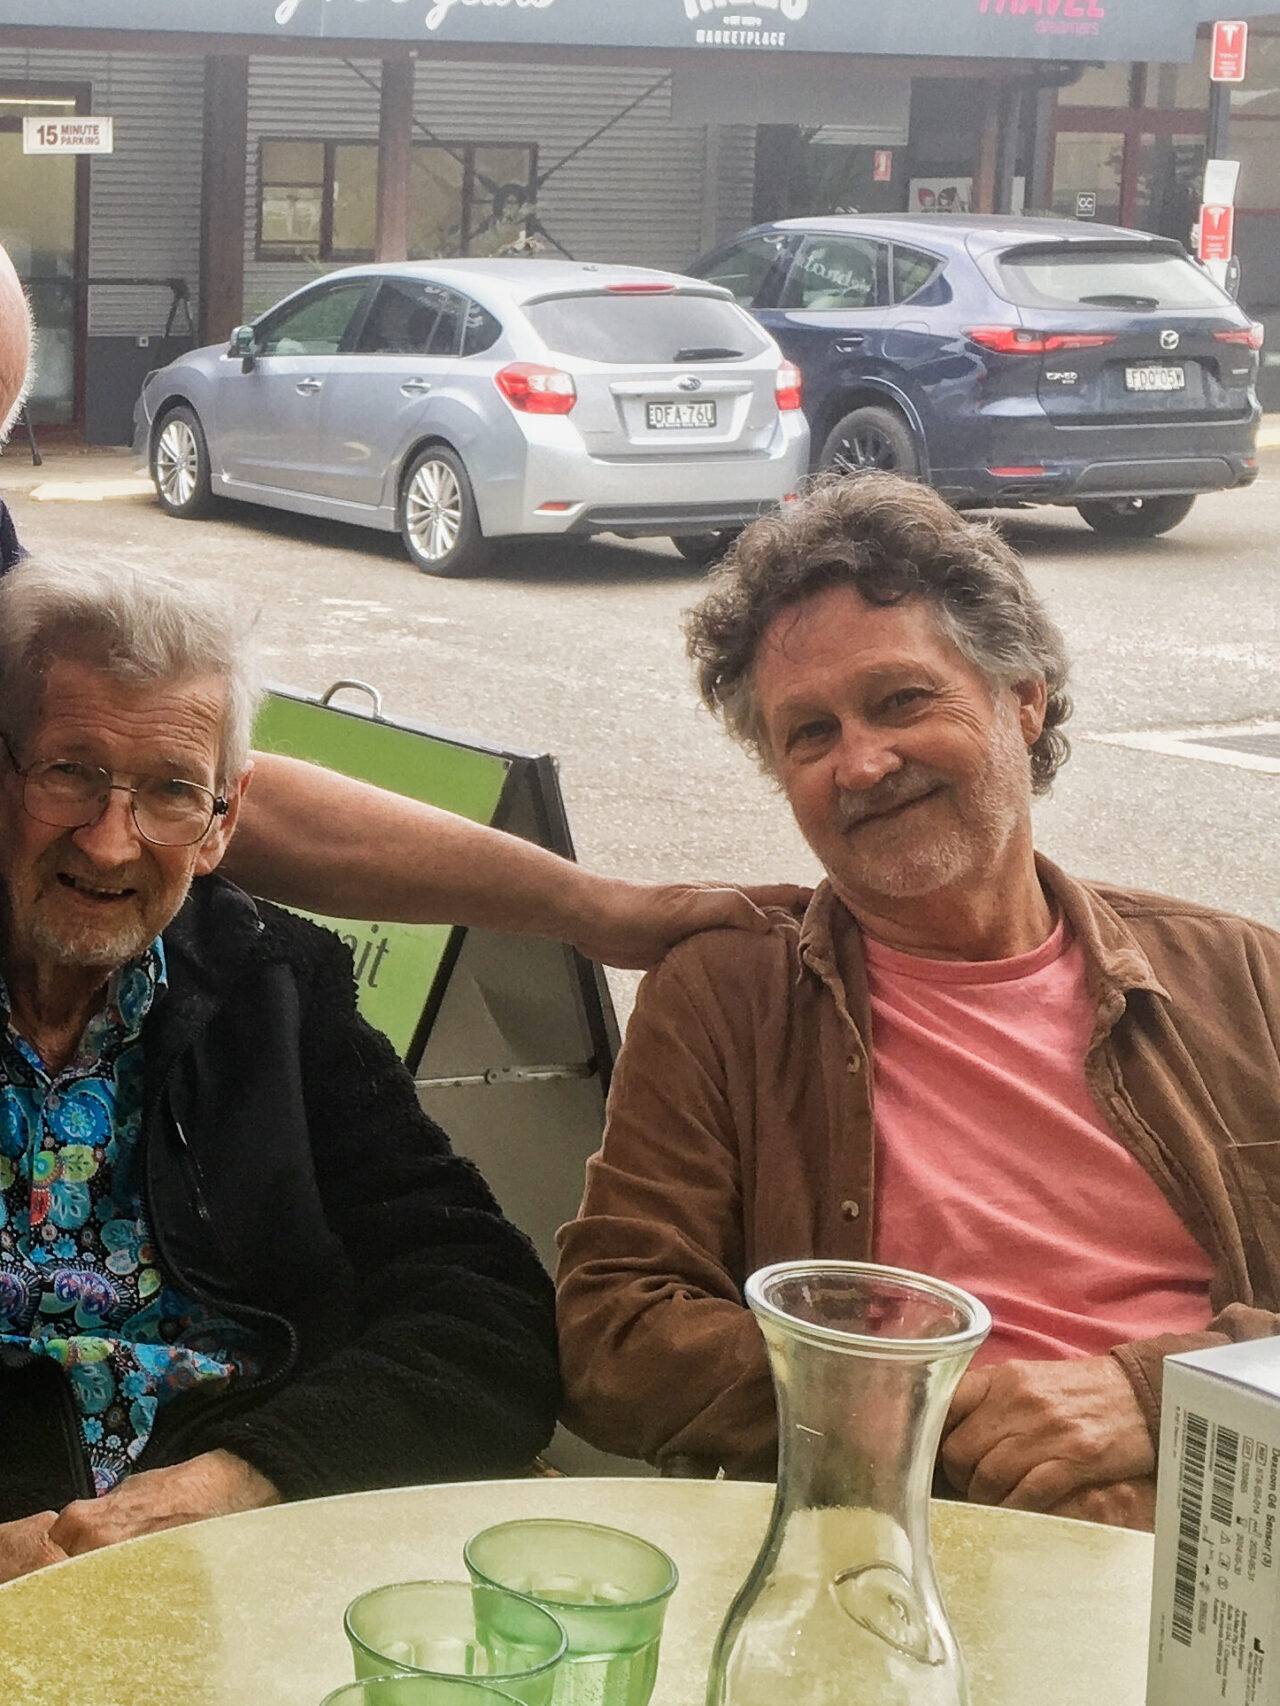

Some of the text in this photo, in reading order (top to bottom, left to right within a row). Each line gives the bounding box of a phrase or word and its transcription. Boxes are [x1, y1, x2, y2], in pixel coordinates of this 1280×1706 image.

[696, 29, 785, 46] MARKETPLACE
[37, 125, 99, 145] 15 MINUTE
[61, 136, 99, 145] PARKING
[1269, 1448, 1280, 1491] Dexcom
[1267, 1493, 1278, 1509] G6
[1263, 1514, 1276, 1552] Sensor
